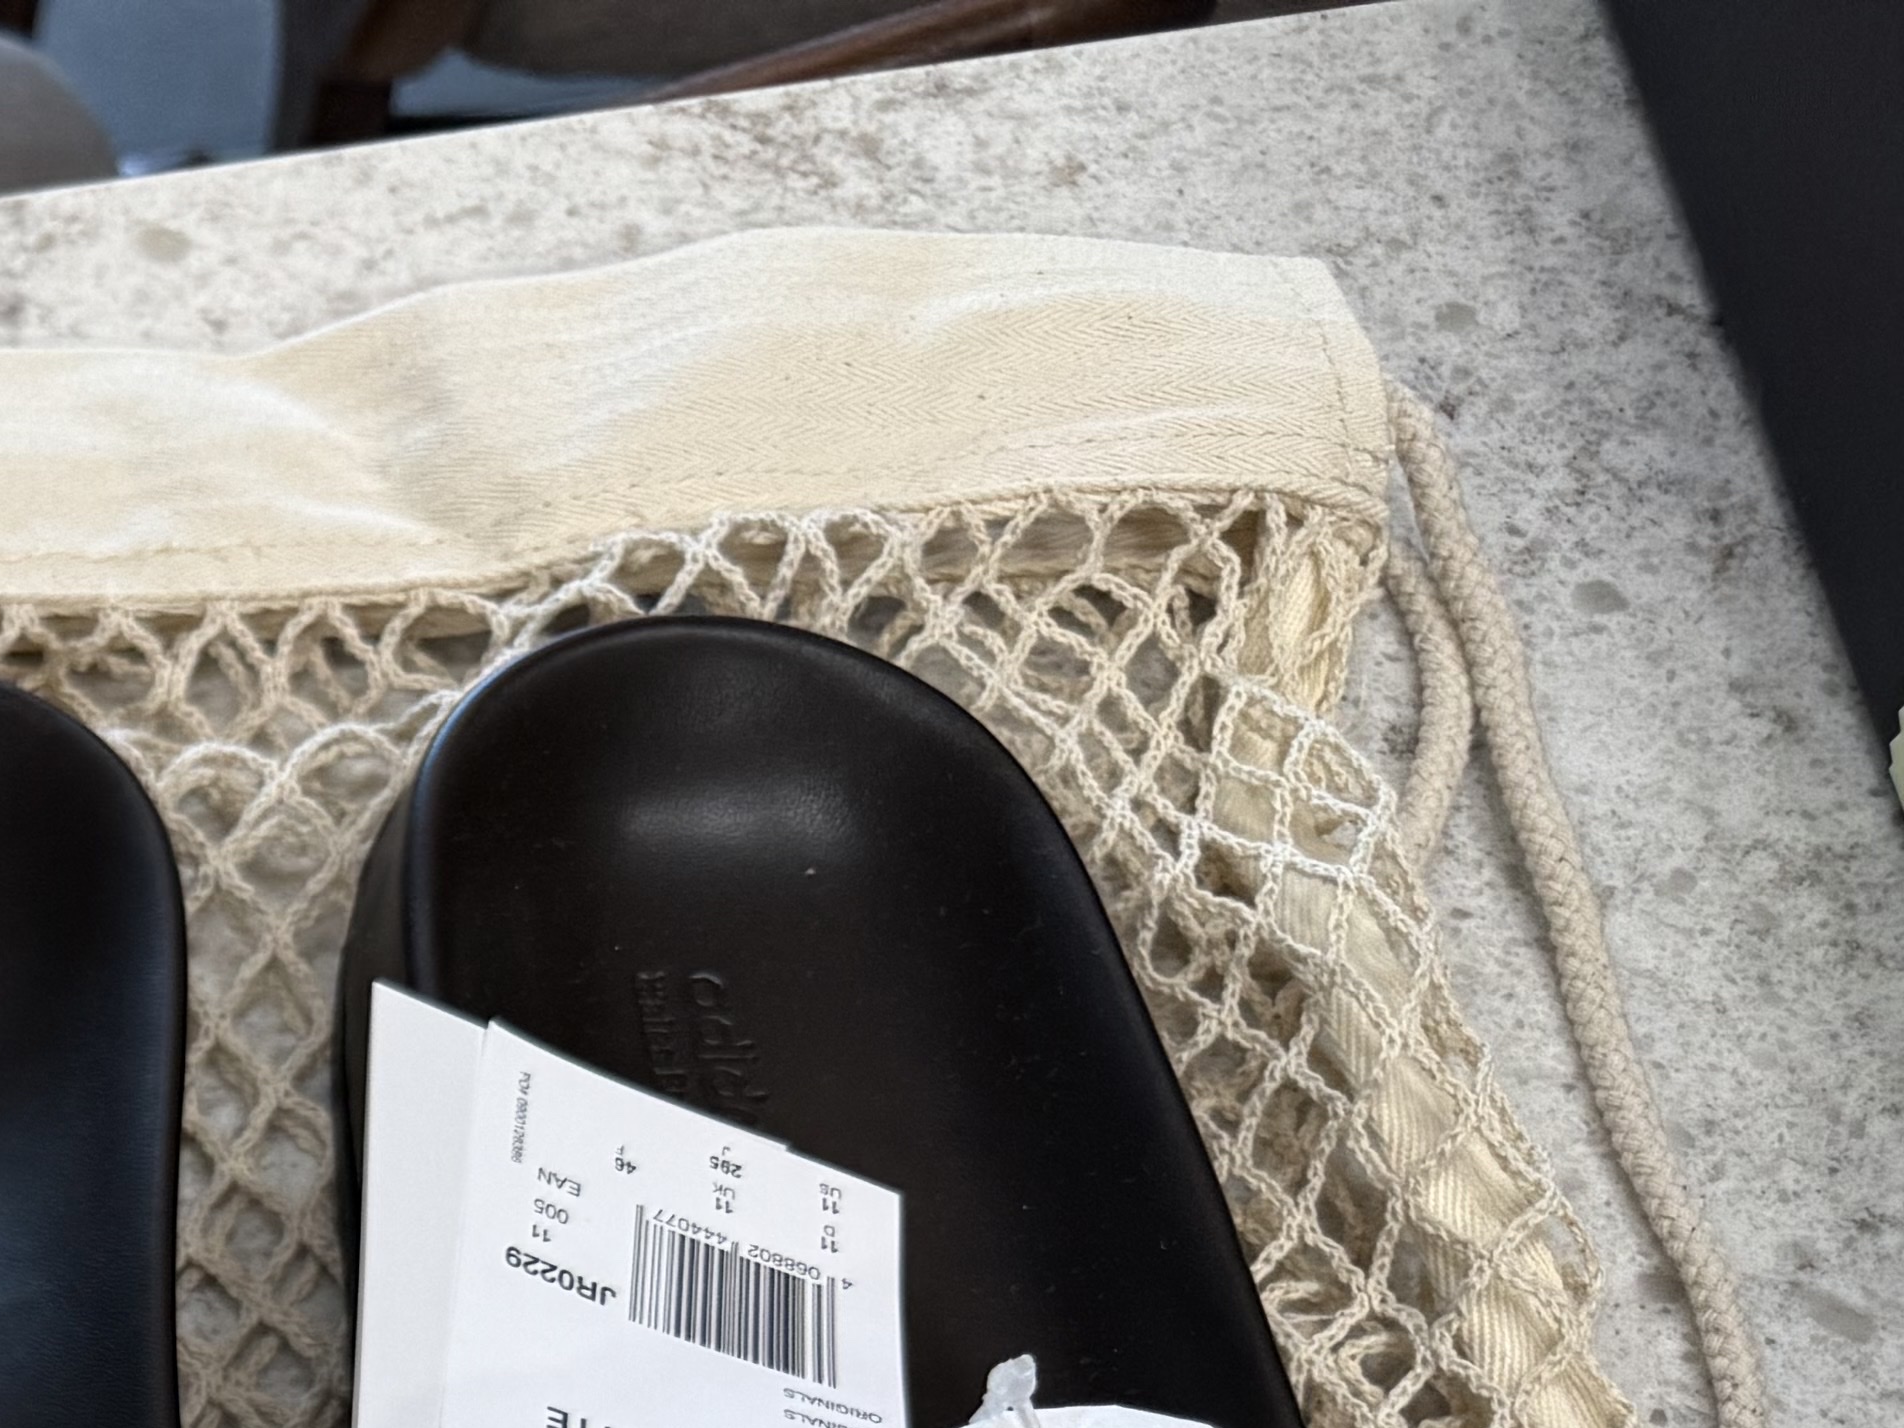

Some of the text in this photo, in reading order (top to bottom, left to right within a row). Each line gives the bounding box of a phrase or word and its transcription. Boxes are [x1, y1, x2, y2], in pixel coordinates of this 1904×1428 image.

[708, 1155, 743, 1179] 295
[536, 1166, 582, 1198] EAN
[711, 1181, 737, 1200] UK
[532, 1197, 570, 1225] 005
[714, 1196, 734, 1215] 11
[821, 1196, 841, 1215] 11
[530, 1223, 552, 1244] 11
[820, 1236, 840, 1254] 11
[652, 1208, 854, 1291] 4 068802 444077
[504, 1245, 617, 1307] JR0229
[782, 1386, 884, 1425] ORIGINALS
